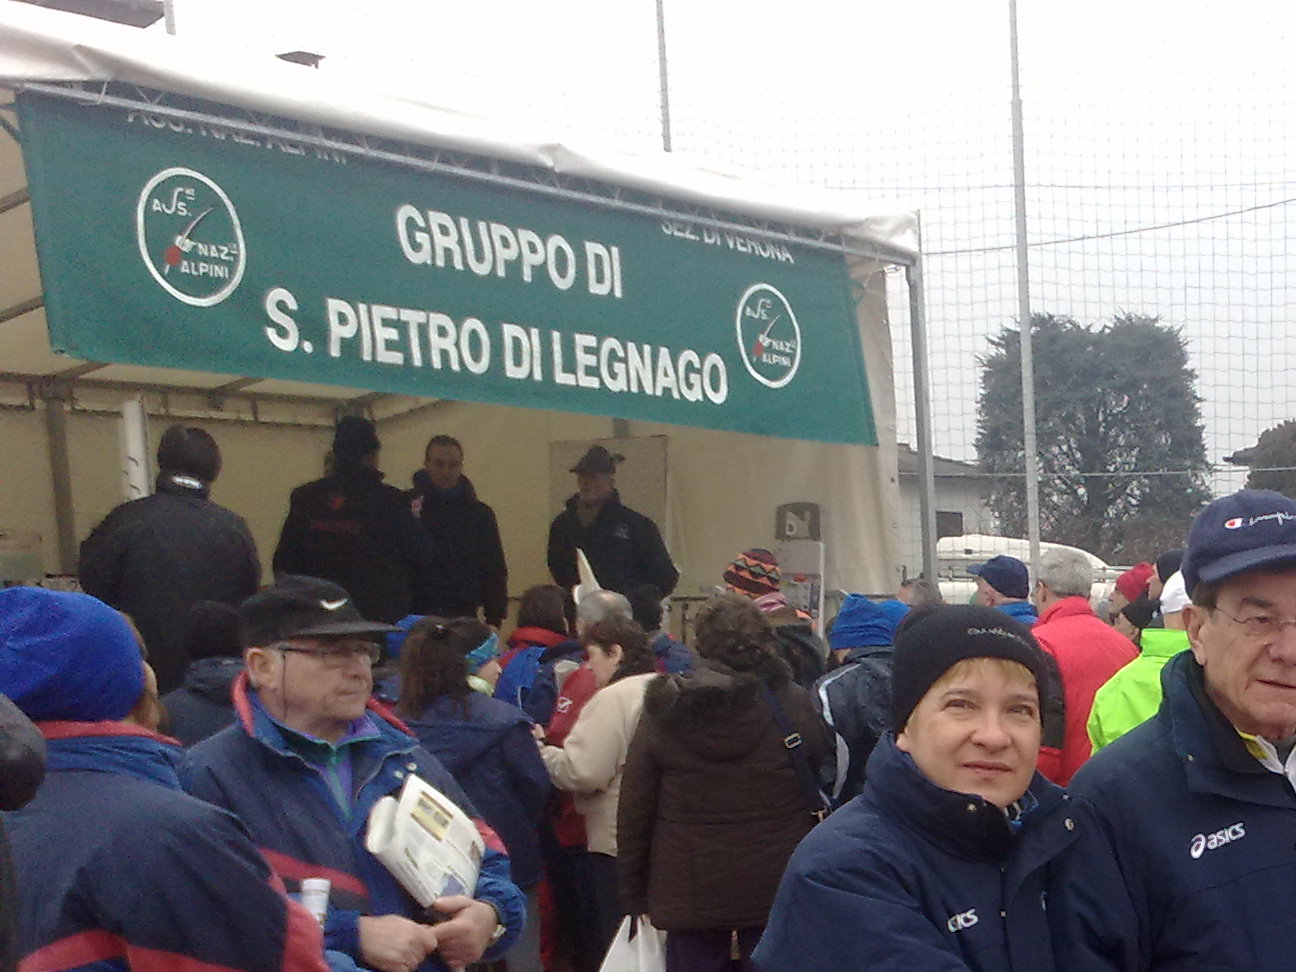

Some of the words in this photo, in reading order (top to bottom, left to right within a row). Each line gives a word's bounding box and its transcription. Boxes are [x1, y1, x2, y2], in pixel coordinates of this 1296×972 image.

[180, 259, 230, 279] ALPINI
[396, 203, 577, 291] GRUPPO
[584, 240, 623, 299] DI
[264, 287, 313, 354] S.
[326, 297, 492, 374] PIETRO
[501, 322, 543, 381] DI
[551, 330, 729, 405] LEGNAGO
[1206, 821, 1246, 851] asics
